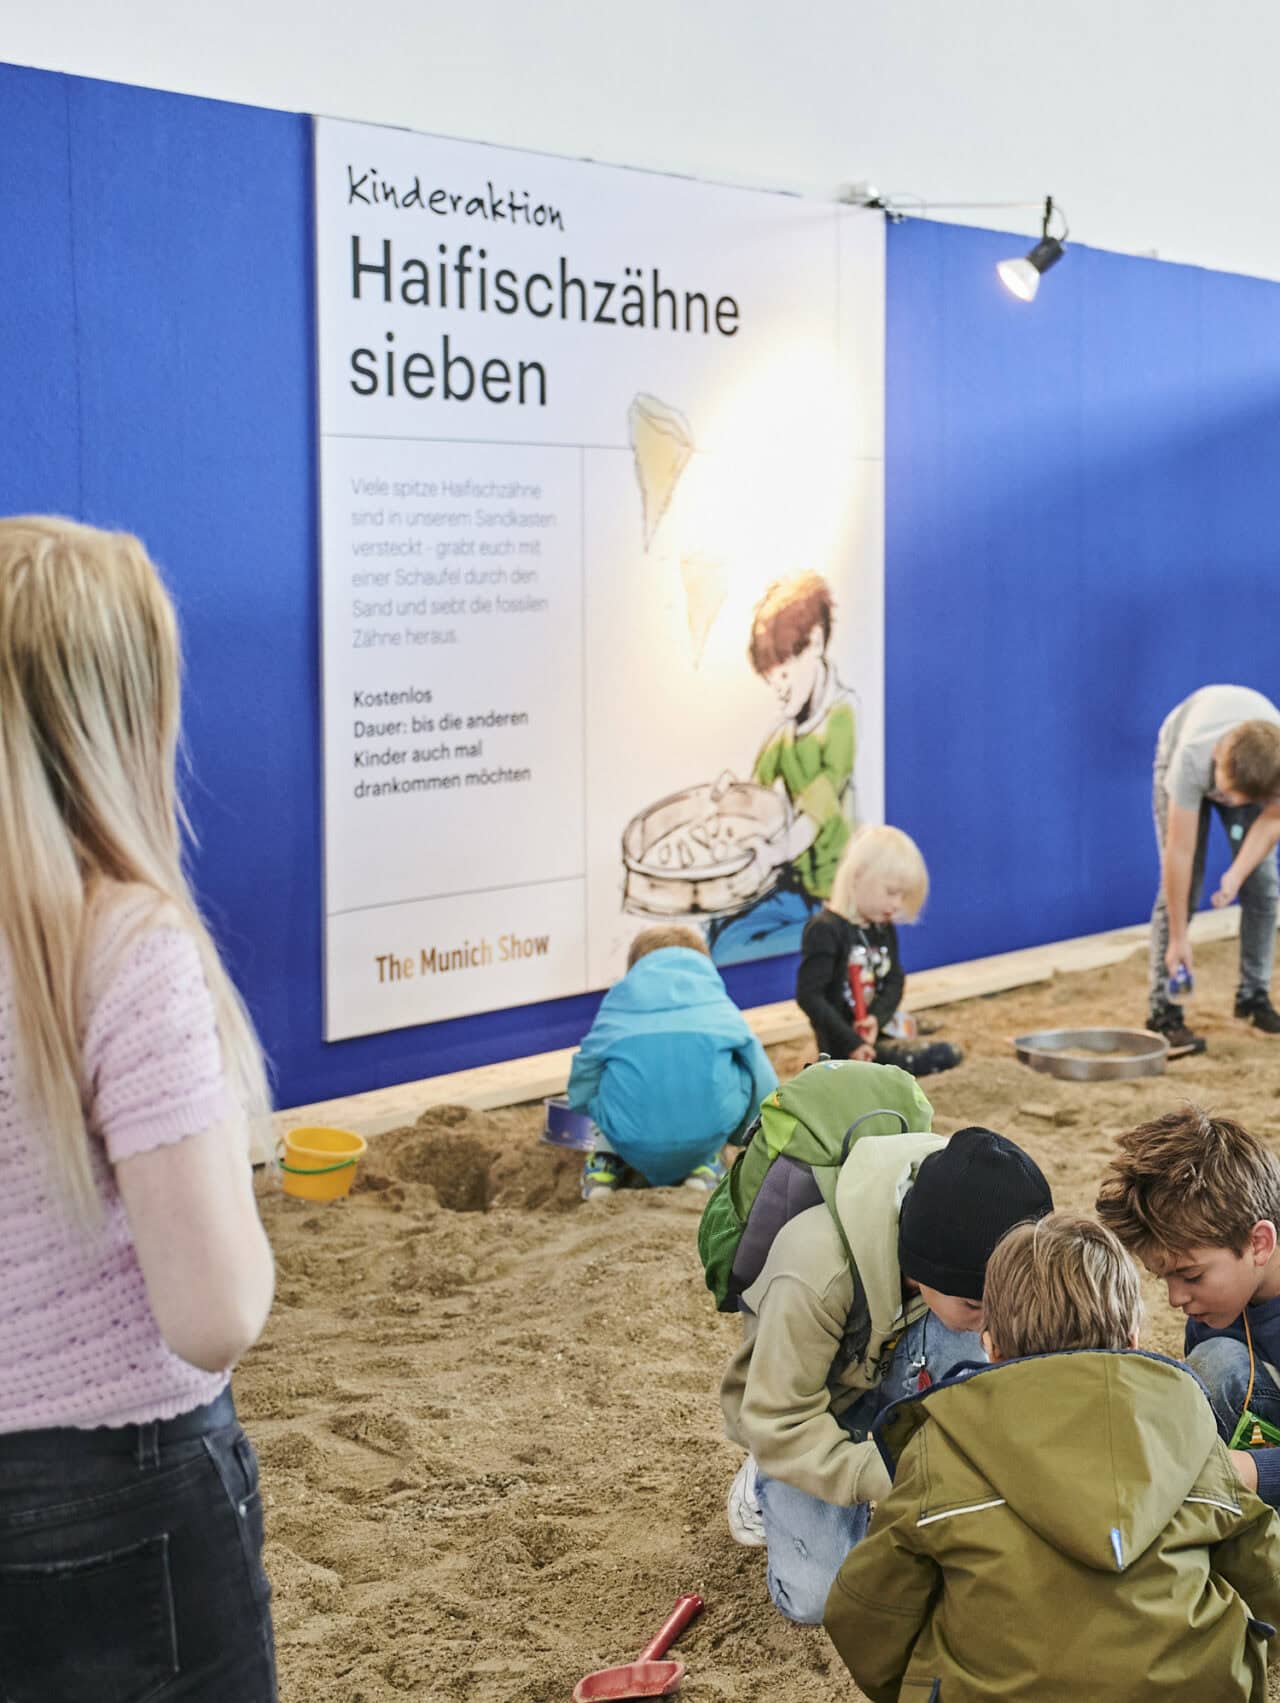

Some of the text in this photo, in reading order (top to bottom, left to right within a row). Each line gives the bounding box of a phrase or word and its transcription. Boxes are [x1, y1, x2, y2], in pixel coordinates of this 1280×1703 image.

[347, 165, 566, 232] Kinderaktion
[350, 235, 742, 337] Haifischzähne
[350, 332, 548, 406] sieben
[351, 477, 542, 499] Viele spitze Haifischzähne
[352, 508, 384, 526] sind
[389, 509, 402, 526] in
[475, 509, 557, 528] Sandkasten
[352, 538, 423, 556] versteckt
[436, 540, 475, 560] grabt
[479, 541, 515, 556] euch
[519, 540, 541, 556] mit
[352, 567, 539, 587] einer Schaufel durch den
[352, 600, 393, 617] Sand
[396, 600, 427, 616] und
[431, 599, 466, 615] siebt
[470, 597, 492, 614] die
[352, 628, 401, 649] Zähne
[353, 686, 432, 708] Kostenlos
[354, 710, 529, 738] Dauer: bis die anderen
[354, 741, 483, 767] Kinder auch mal
[354, 767, 532, 798] drankommen möchten
[375, 934, 550, 983] The Munich Show
